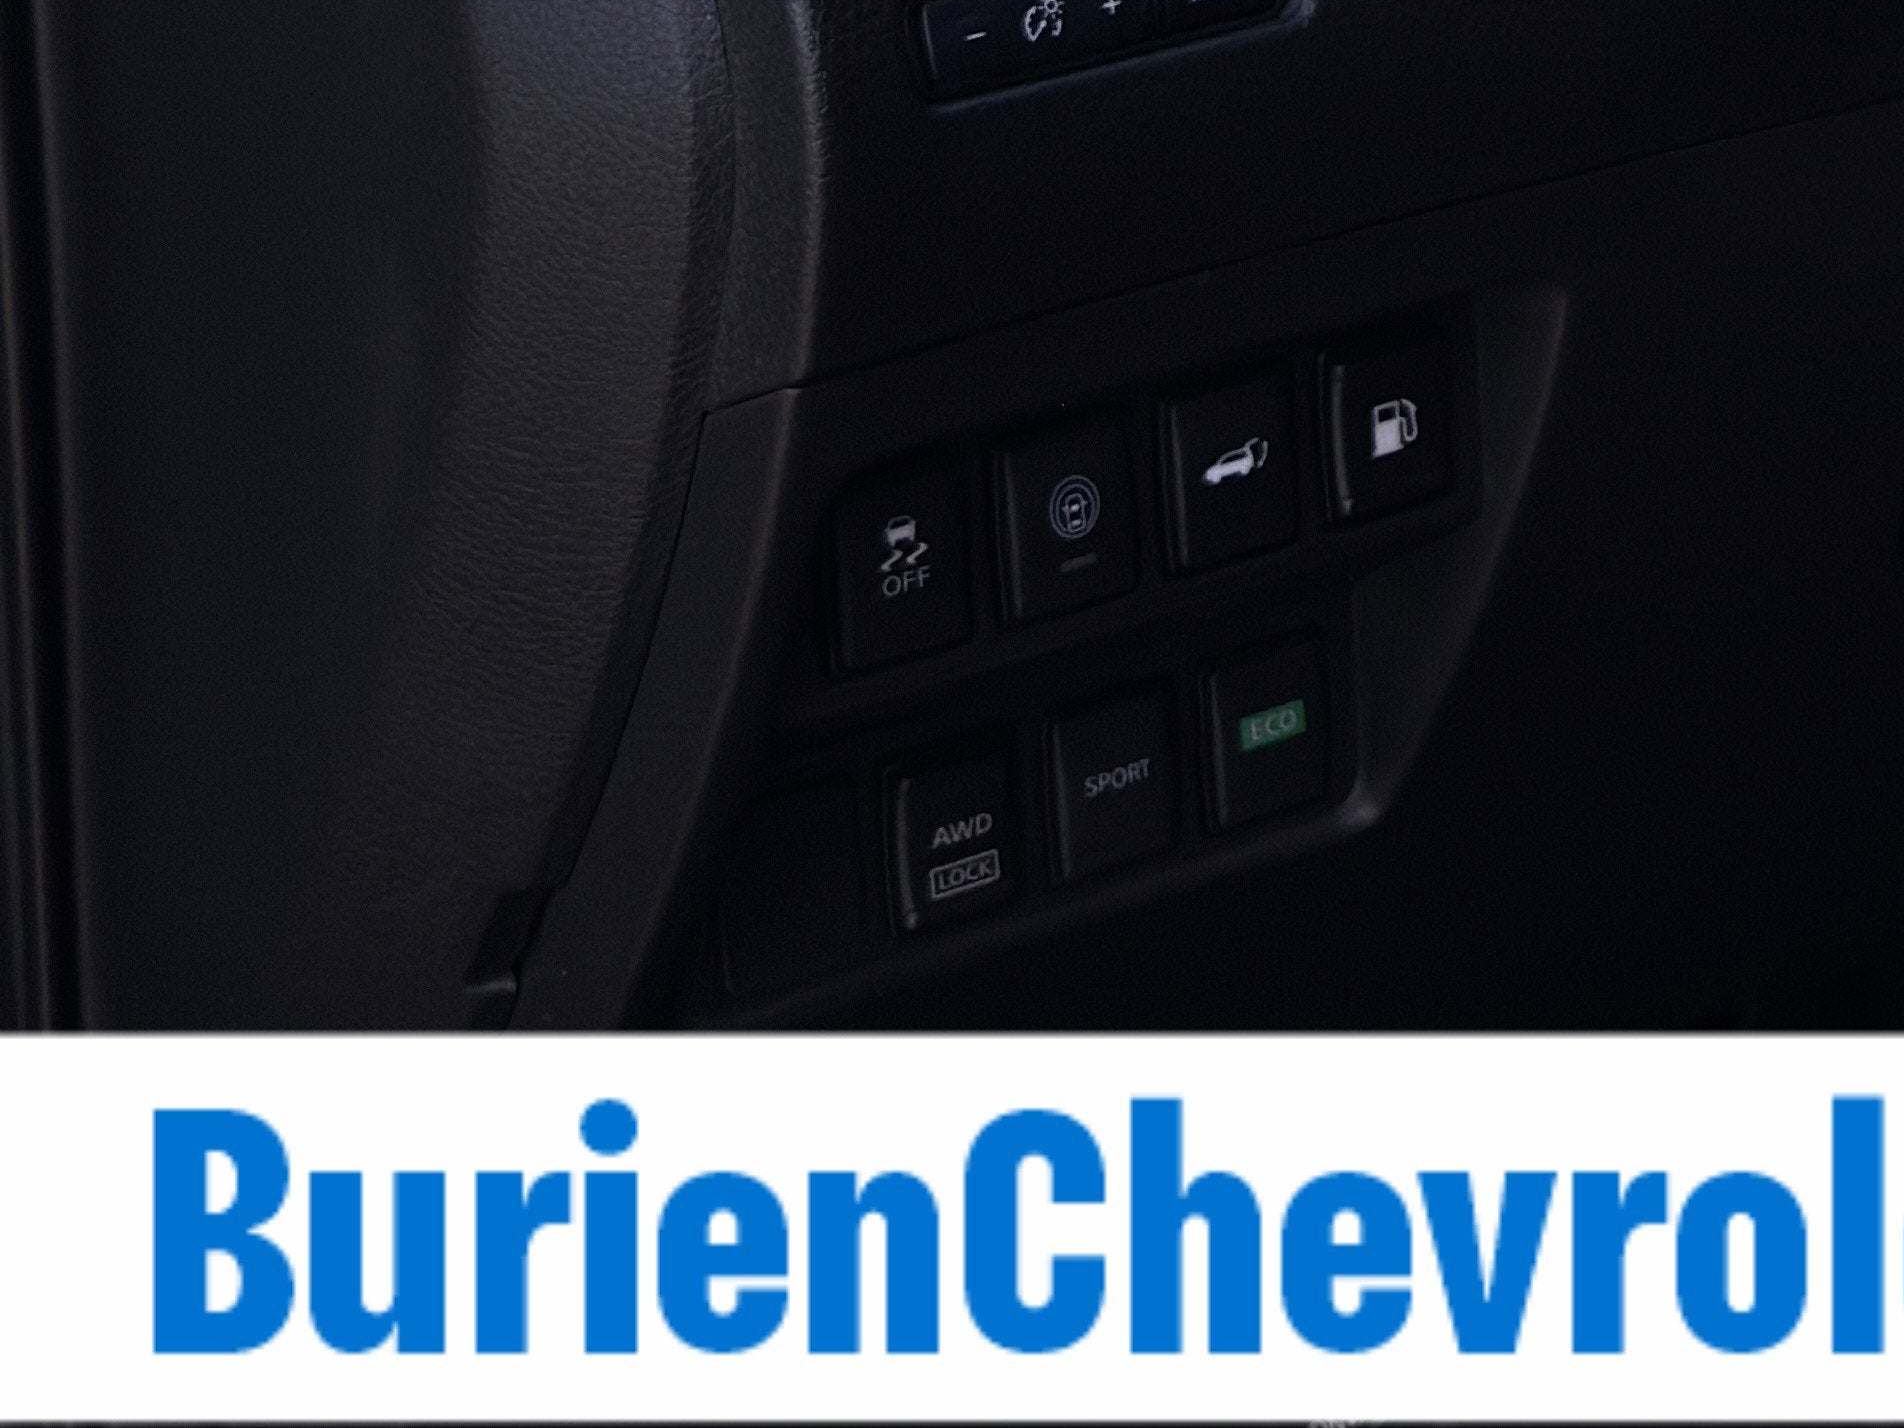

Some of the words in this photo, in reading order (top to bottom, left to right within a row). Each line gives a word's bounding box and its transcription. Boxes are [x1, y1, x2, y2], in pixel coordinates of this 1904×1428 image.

[881, 564, 931, 599] OFF
[1248, 707, 1299, 744] ECO
[1083, 757, 1151, 799] SPORT
[932, 811, 993, 850] AWD
[936, 858, 993, 894] LOCK
